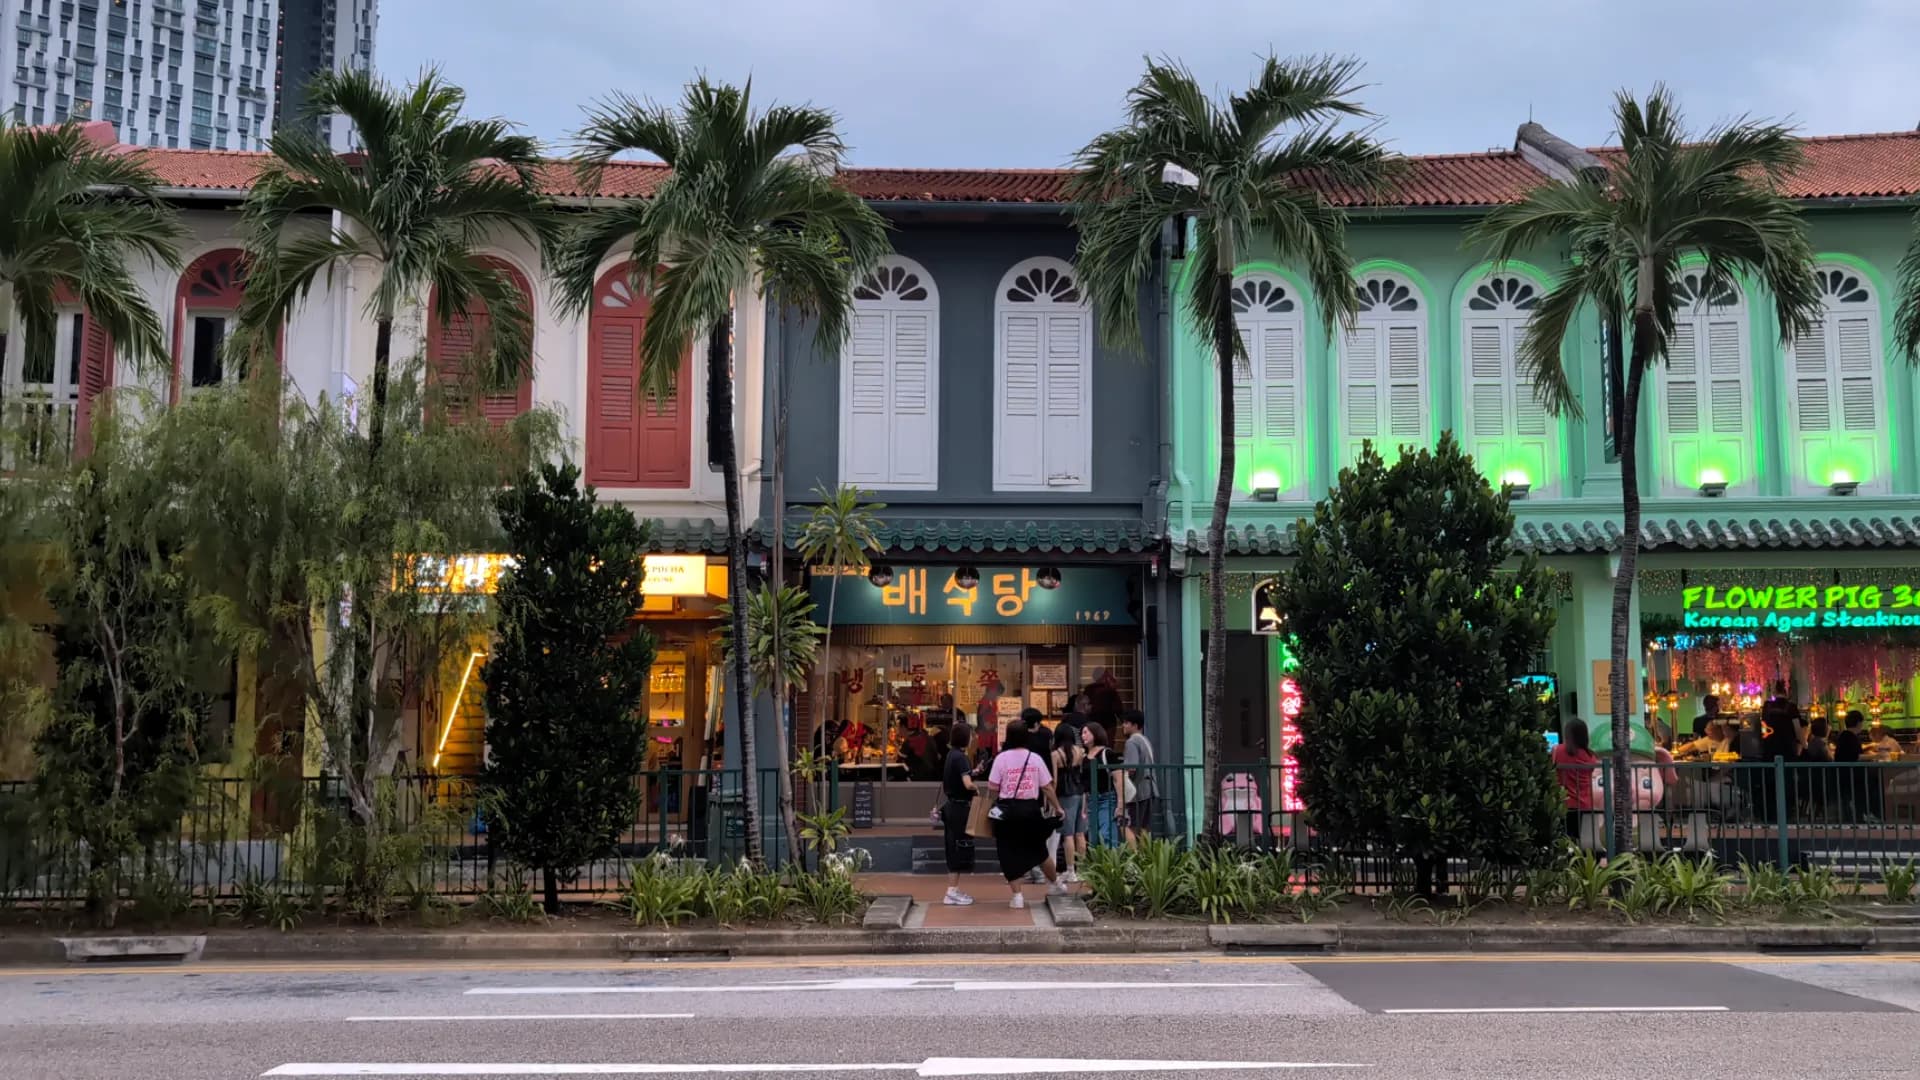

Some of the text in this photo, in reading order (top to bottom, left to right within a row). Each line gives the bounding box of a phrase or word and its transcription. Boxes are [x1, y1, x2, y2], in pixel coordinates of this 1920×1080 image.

[1682, 586, 1818, 609] FLOWER
[1825, 584, 1882, 609] PIG
[1076, 610, 1110, 621] 1969
[1684, 612, 1759, 628] Korean
[1763, 611, 1817, 633] Aged
